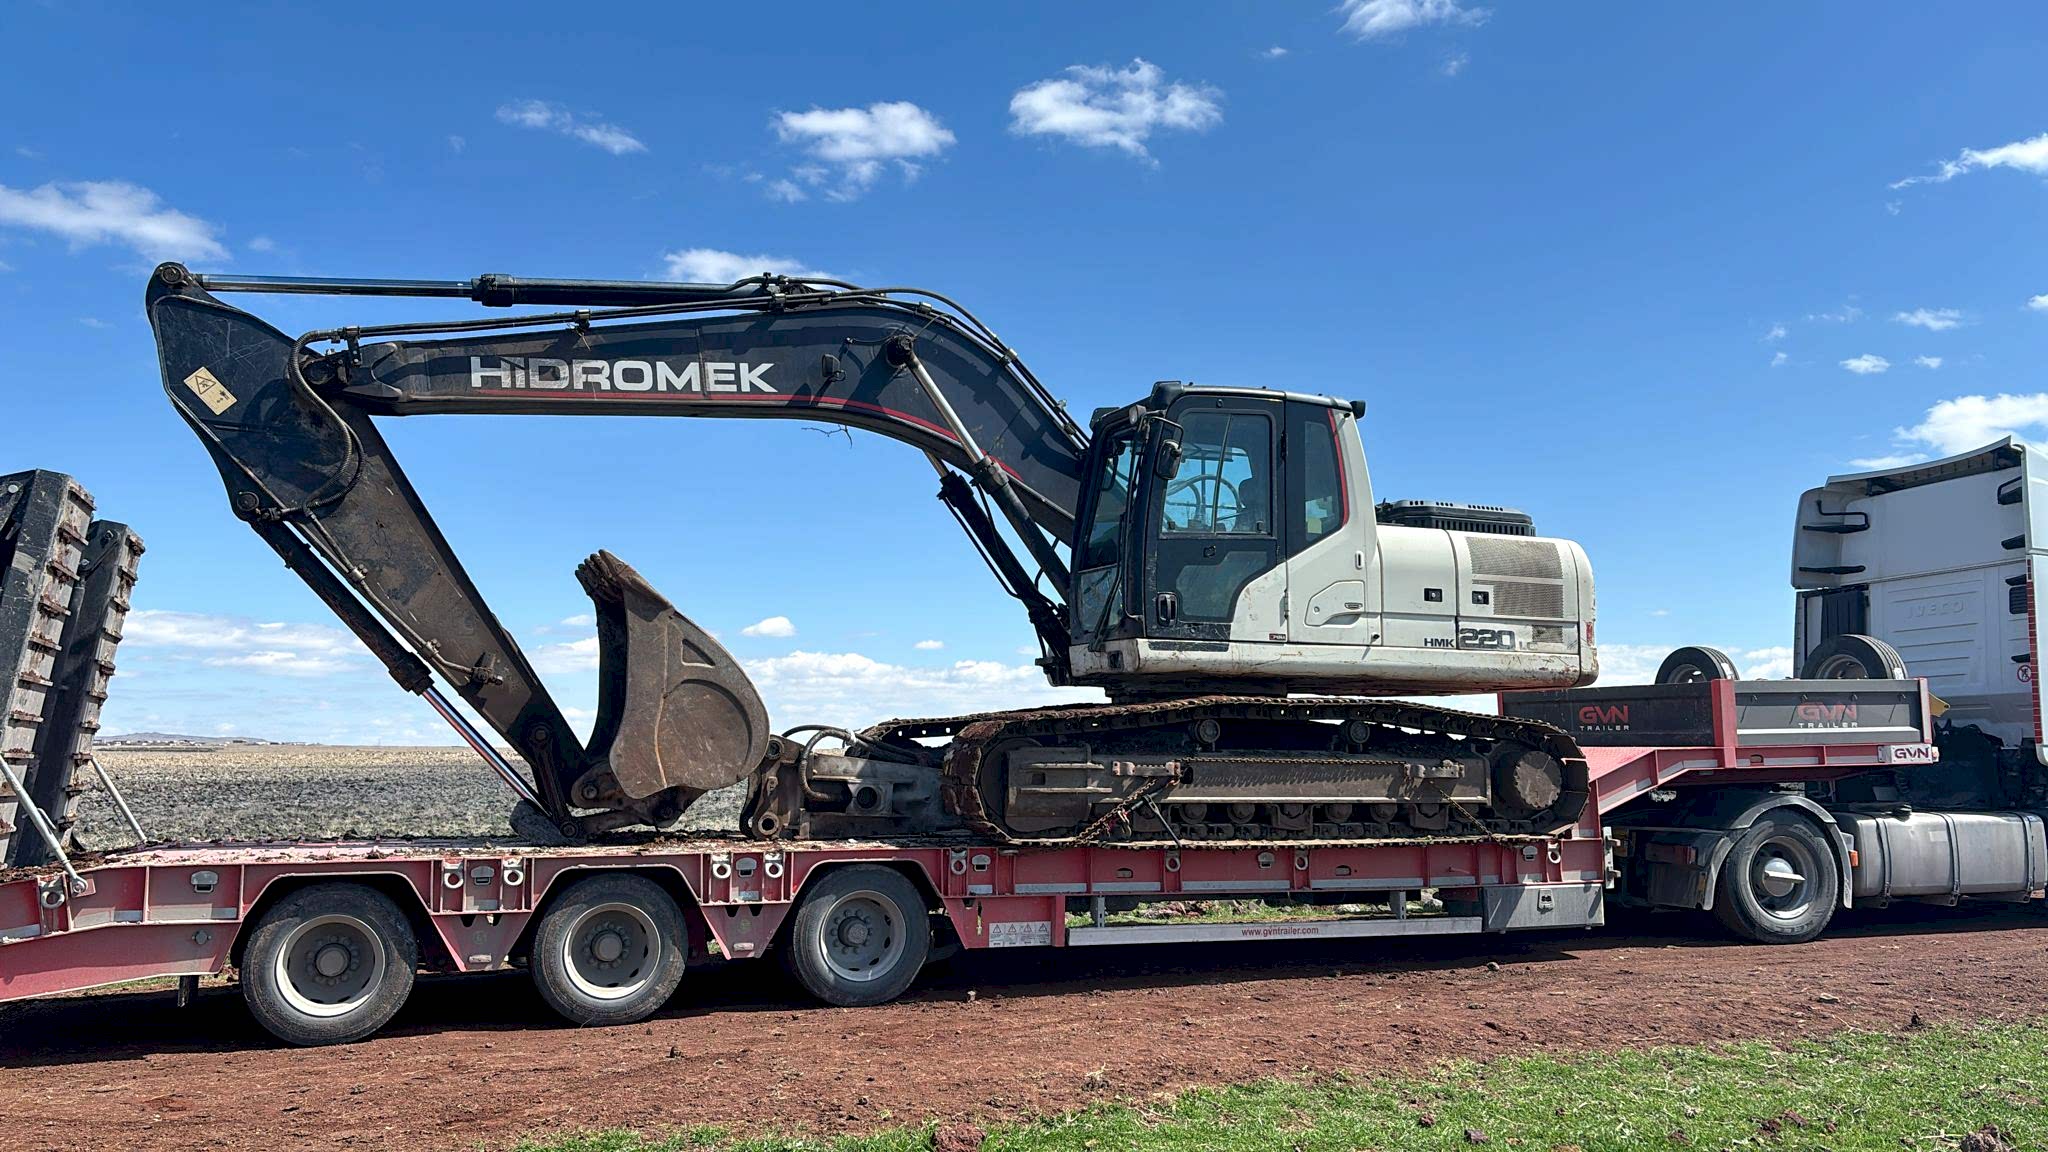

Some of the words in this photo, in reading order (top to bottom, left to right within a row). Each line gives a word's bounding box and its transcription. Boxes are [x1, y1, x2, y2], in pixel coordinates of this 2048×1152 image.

[1423, 637, 1455, 648] HMK
[1459, 627, 1516, 651] 220
[1579, 704, 1629, 724] GVN
[1797, 702, 1857, 721] GVN
[1798, 721, 1858, 729] TRAILER
[1894, 747, 1930, 759] GVN
[1241, 926, 1319, 937] www.gvntrailer.com
